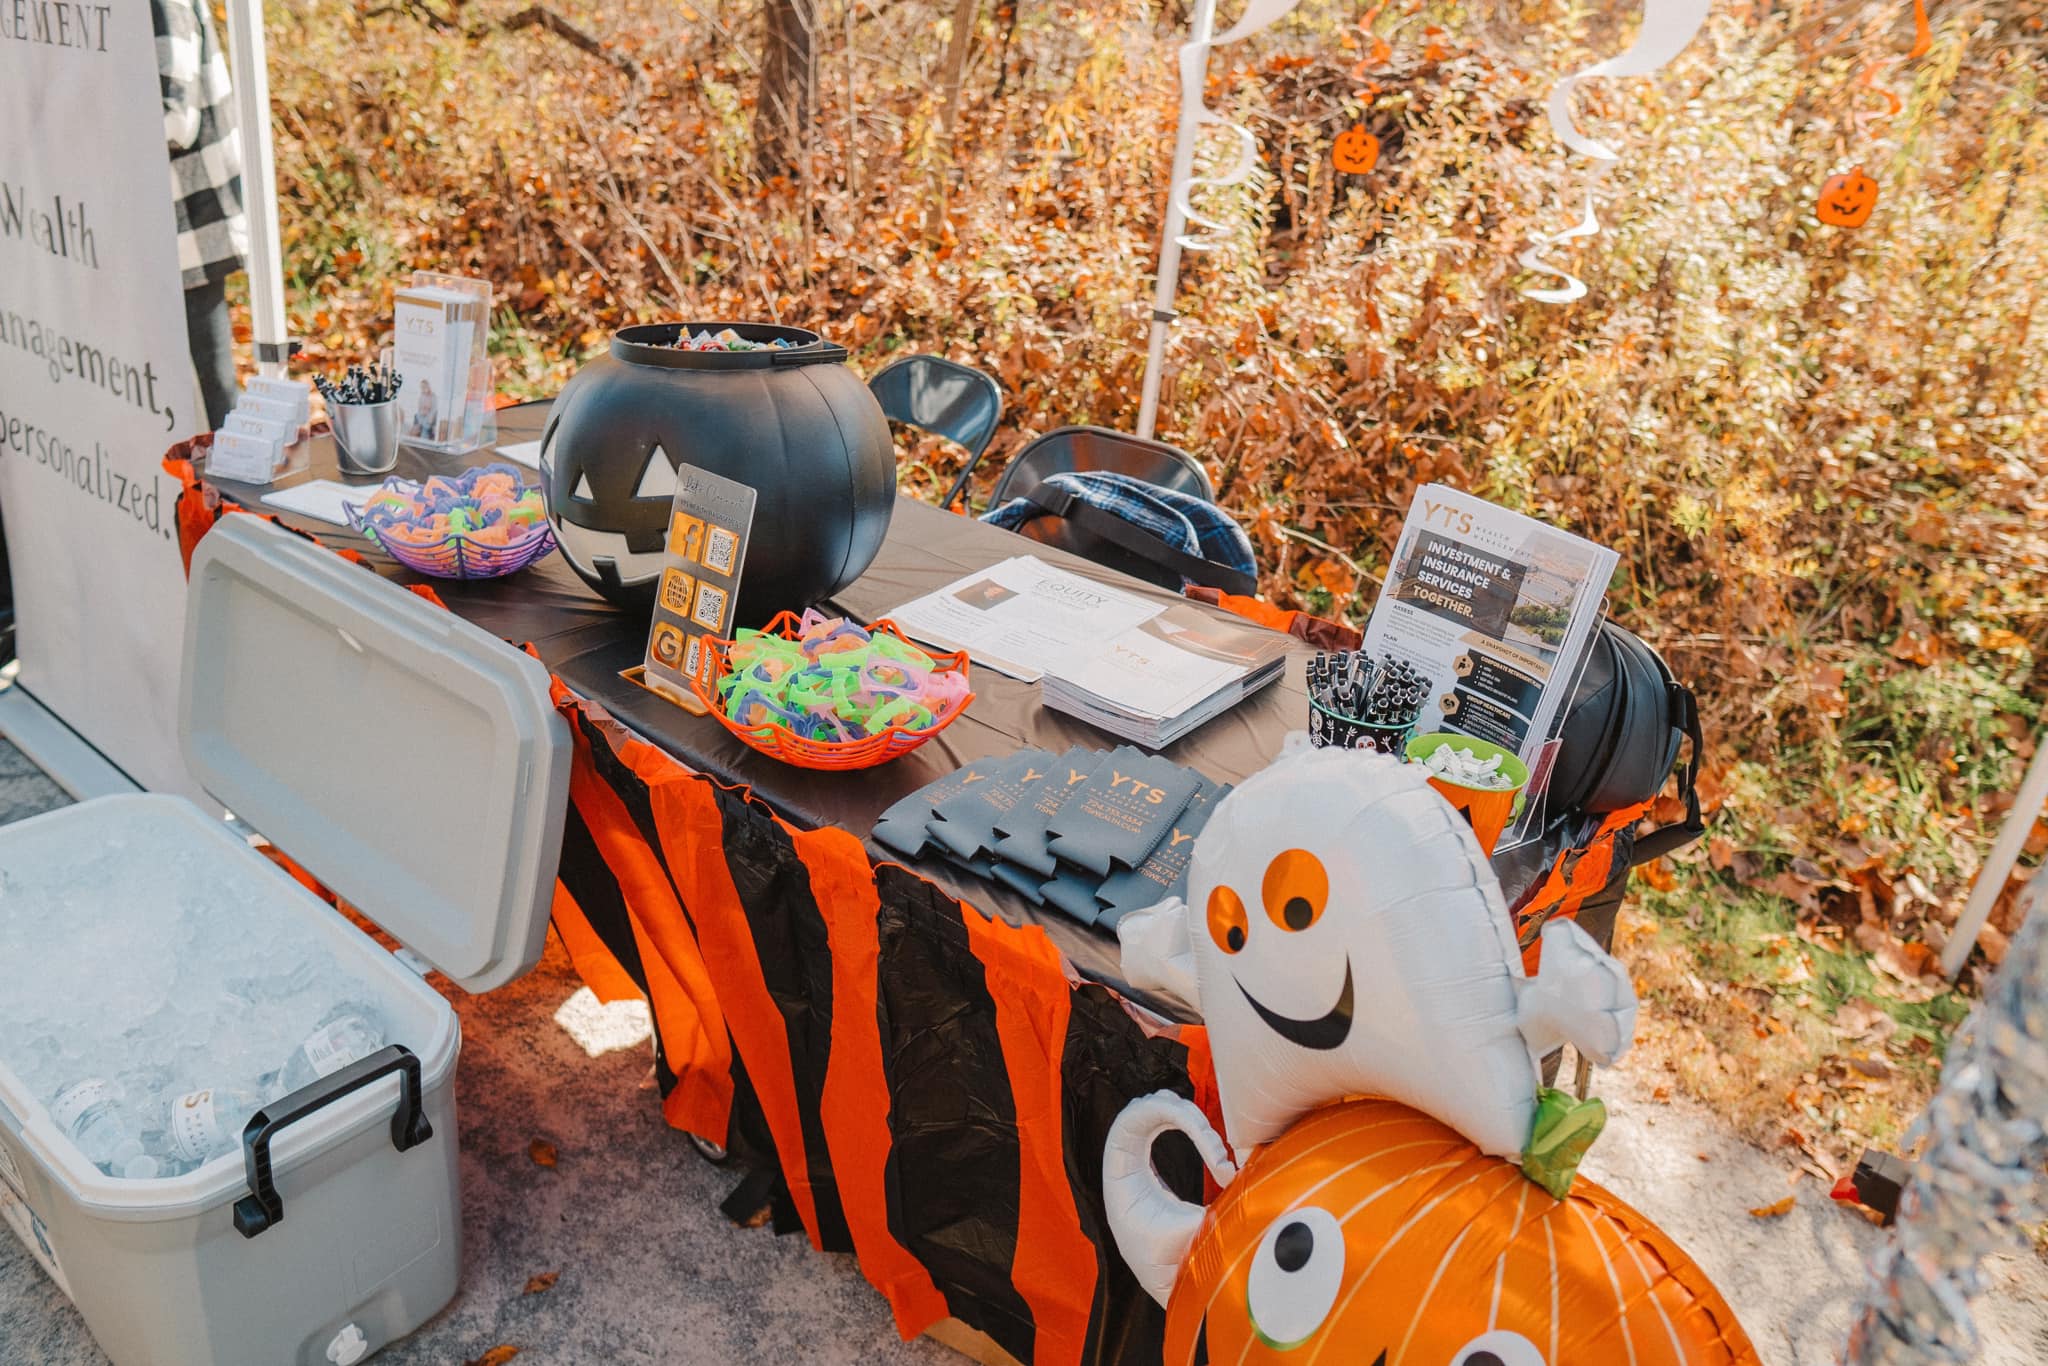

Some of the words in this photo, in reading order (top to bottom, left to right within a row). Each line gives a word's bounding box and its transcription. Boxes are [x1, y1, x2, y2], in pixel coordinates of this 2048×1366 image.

[0, 182, 99, 269] Wealth
[1423, 498, 1474, 535] YTS
[1422, 555, 1491, 589] INSURANCE
[1427, 540, 1501, 576] INVESTMENT
[1501, 567, 1512, 581] &
[1412, 584, 1474, 618] TOGETHER.
[1417, 570, 1474, 599] SERVICES
[1110, 768, 1168, 804] YTS
